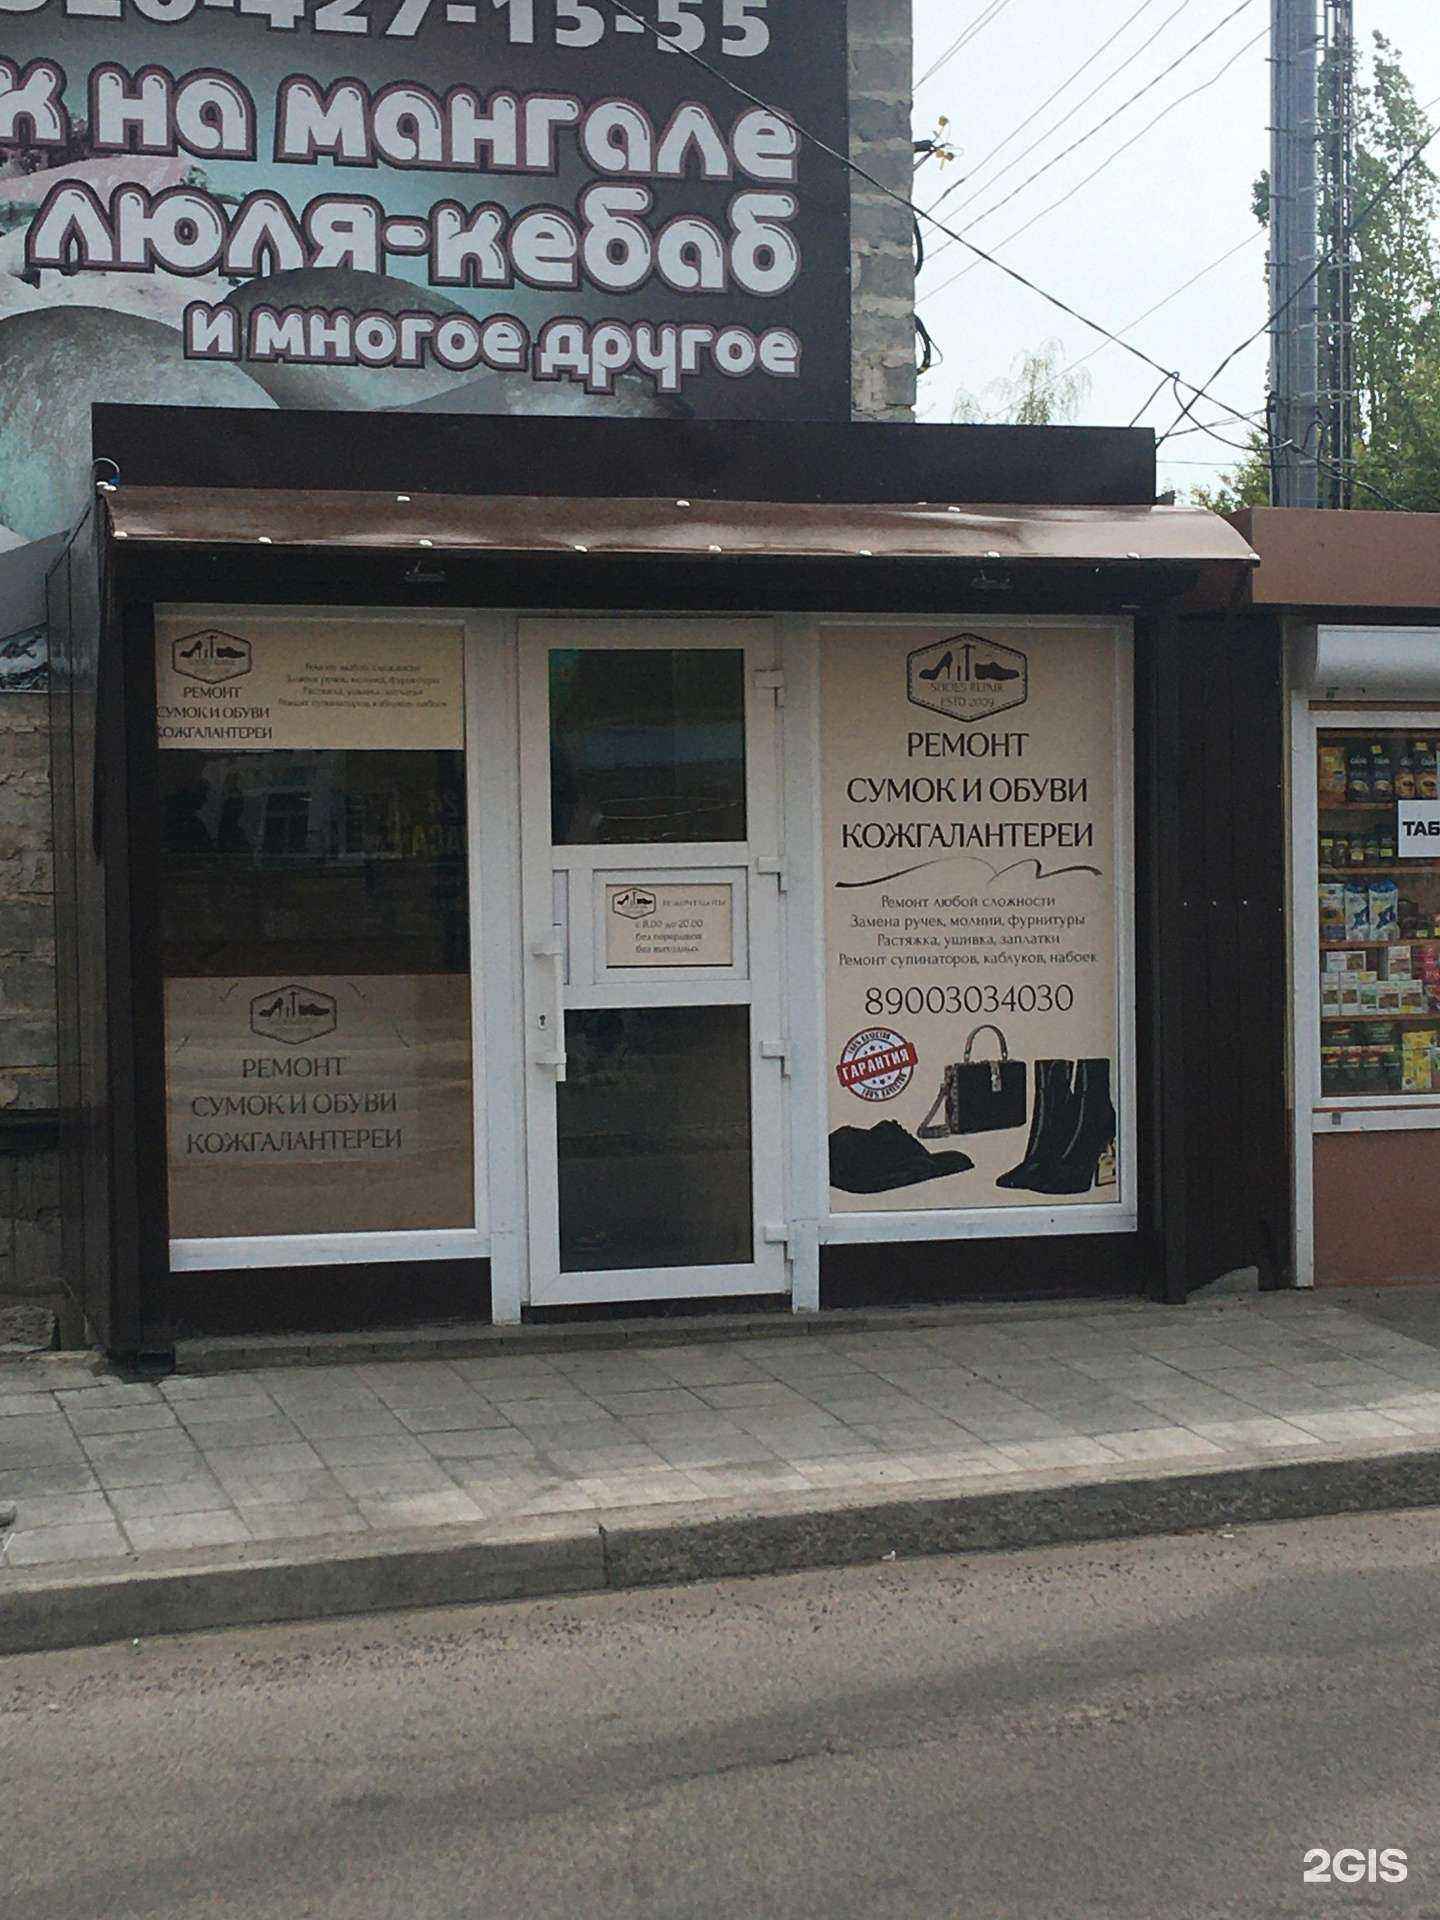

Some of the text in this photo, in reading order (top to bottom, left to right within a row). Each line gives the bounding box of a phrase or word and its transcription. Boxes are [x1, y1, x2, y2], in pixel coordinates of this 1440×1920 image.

[90, 62, 255, 158] на
[276, 74, 797, 180] мангале
[29, 180, 799, 294] люля-кебаб
[184, 301, 799, 393] и многое другое
[183, 686, 242, 698] РЕМОНТ
[223, 706, 270, 718] ОБУВИ
[907, 732, 1029, 757] РЕМОНТ
[847, 778, 1088, 802] СУМОК И ОБУВИ
[842, 823, 1093, 848] КОЖГАЛАНТЕРЕИ
[1403, 821, 1440, 836] ТАБ
[881, 895, 1056, 908] Ремонт любой сложности
[850, 914, 900, 928] Замена
[1007, 914, 1085, 930] фурнитуры
[877, 933, 941, 947] Растяжка,
[999, 932, 1060, 946] заплатки
[839, 950, 1098, 969] Ремонт супинаторов, каблуков, набоек
[865, 984, 1074, 1015] 89003034030
[243, 1056, 347, 1078] РЕМОНТ
[842, 1047, 910, 1081] ГАРАНТИЯ
[191, 1092, 397, 1117] СУМОК И ОБУВИ
